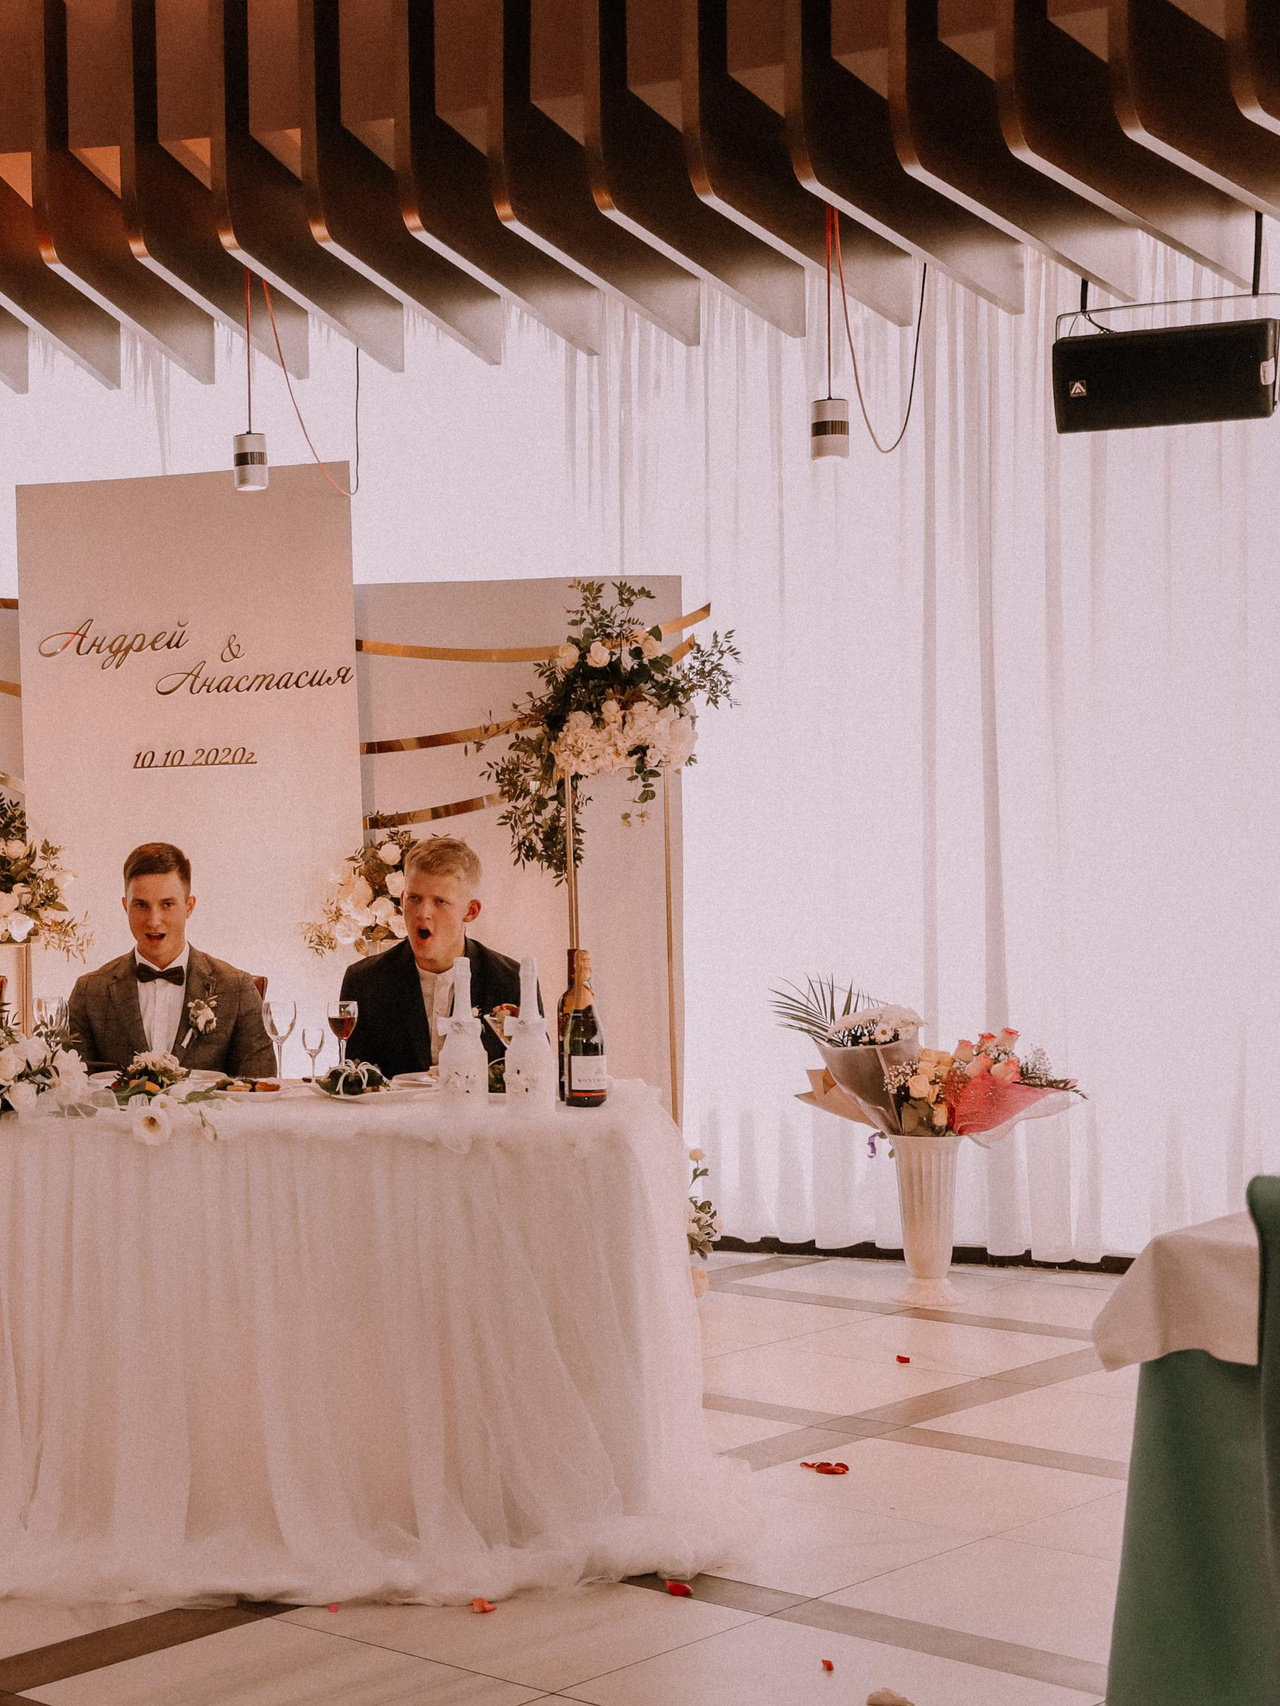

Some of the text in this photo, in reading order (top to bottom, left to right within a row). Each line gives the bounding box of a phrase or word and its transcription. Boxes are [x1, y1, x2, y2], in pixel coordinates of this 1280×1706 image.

[38, 618, 246, 670] Андрей &
[155, 660, 354, 696] Анастасия
